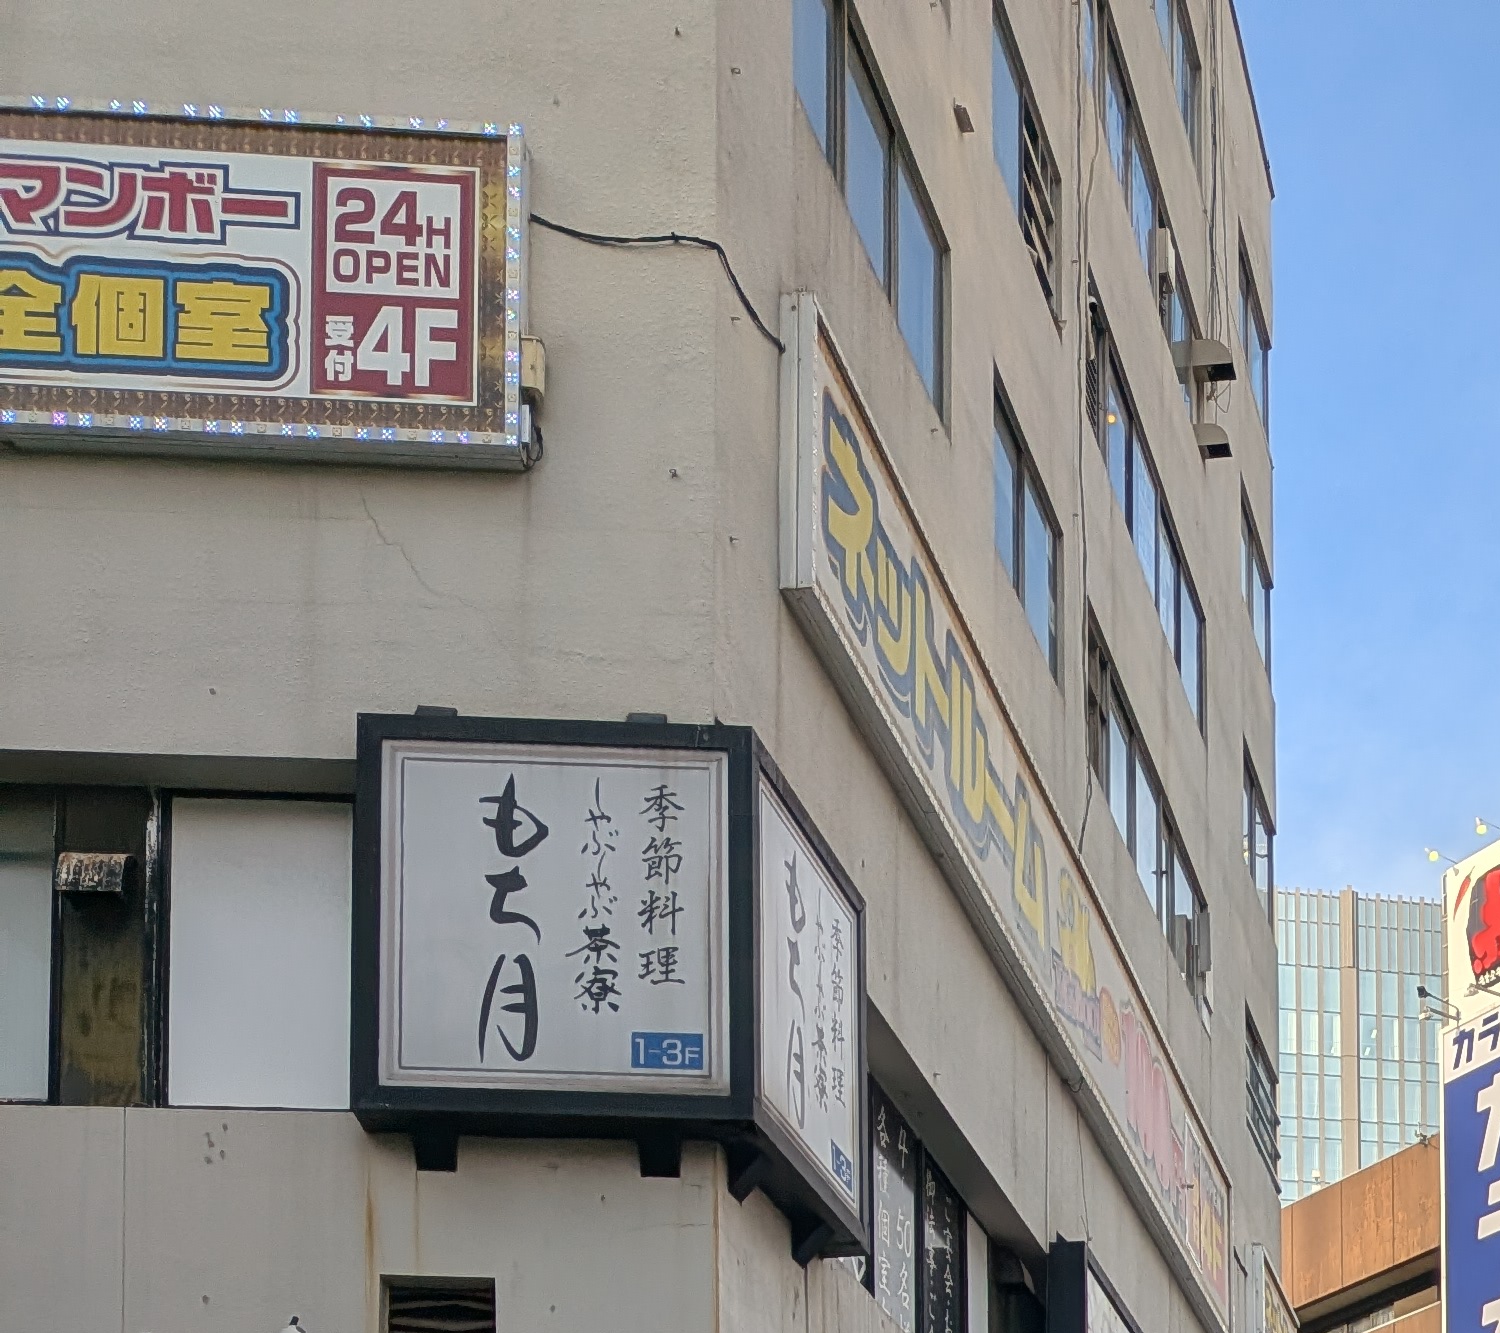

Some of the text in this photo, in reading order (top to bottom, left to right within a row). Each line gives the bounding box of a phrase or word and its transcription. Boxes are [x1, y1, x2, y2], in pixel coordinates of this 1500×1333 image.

[333, 248, 450, 288] OPEN
[335, 187, 451, 246] 24H
[325, 315, 354, 384] 受付
[357, 305, 459, 388] 4F
[478, 773, 549, 1063] もち月
[566, 777, 623, 1014] しゃぶしゃぶ茶寮
[638, 784, 686, 986] 季節料理
[634, 1037, 701, 1065] 1-3F
[784, 851, 807, 1130] もち月
[831, 919, 846, 1109] 季節料理
